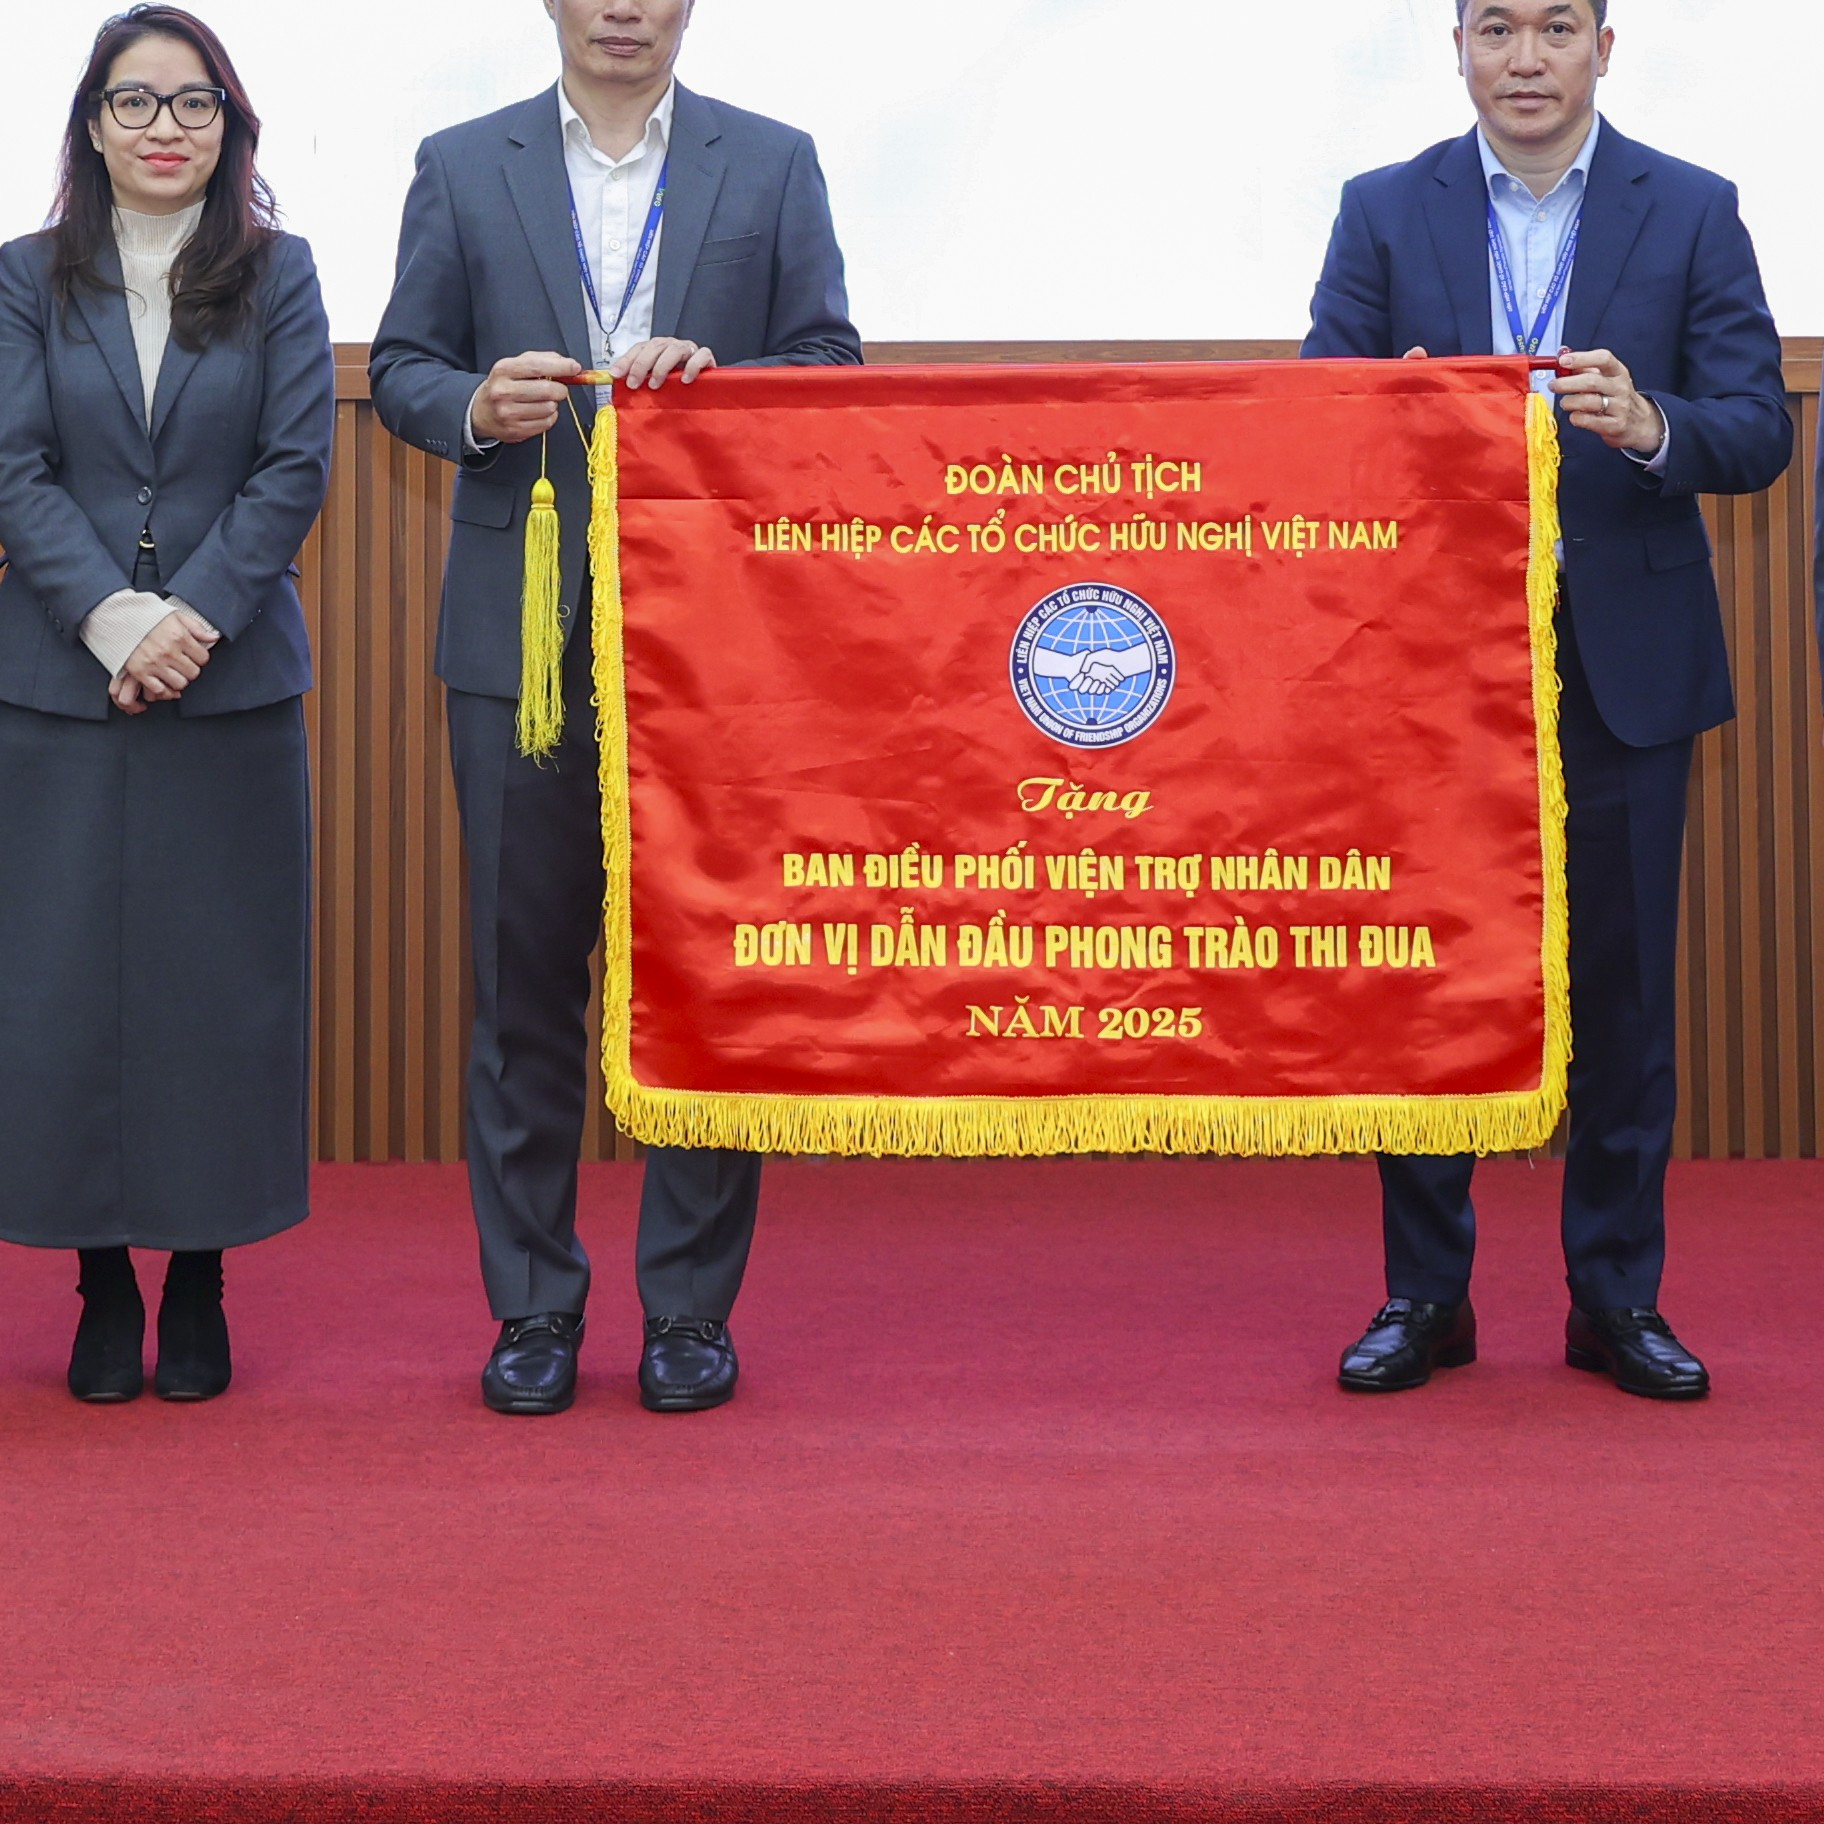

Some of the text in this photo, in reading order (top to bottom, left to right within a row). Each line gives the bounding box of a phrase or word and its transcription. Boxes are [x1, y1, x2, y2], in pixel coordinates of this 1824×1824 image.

[945, 452, 1201, 497] ĐOÀN CHỦ TỊCH
[755, 507, 1398, 561] LIÊN HIỆP CÁC TỔ CHỨC HỮU NGHỊ VIỆT NAM
[1016, 778, 1154, 818] Tặng
[783, 840, 1391, 898] BAN ĐIỀU PHỐI VIỆN TRỢ NHÂN DÂN
[733, 907, 1436, 975] ĐƠN VỊ DẪN ĐẦU PHONG TRÀO THI ĐUA
[966, 995, 1203, 1039] NĂM 2025
